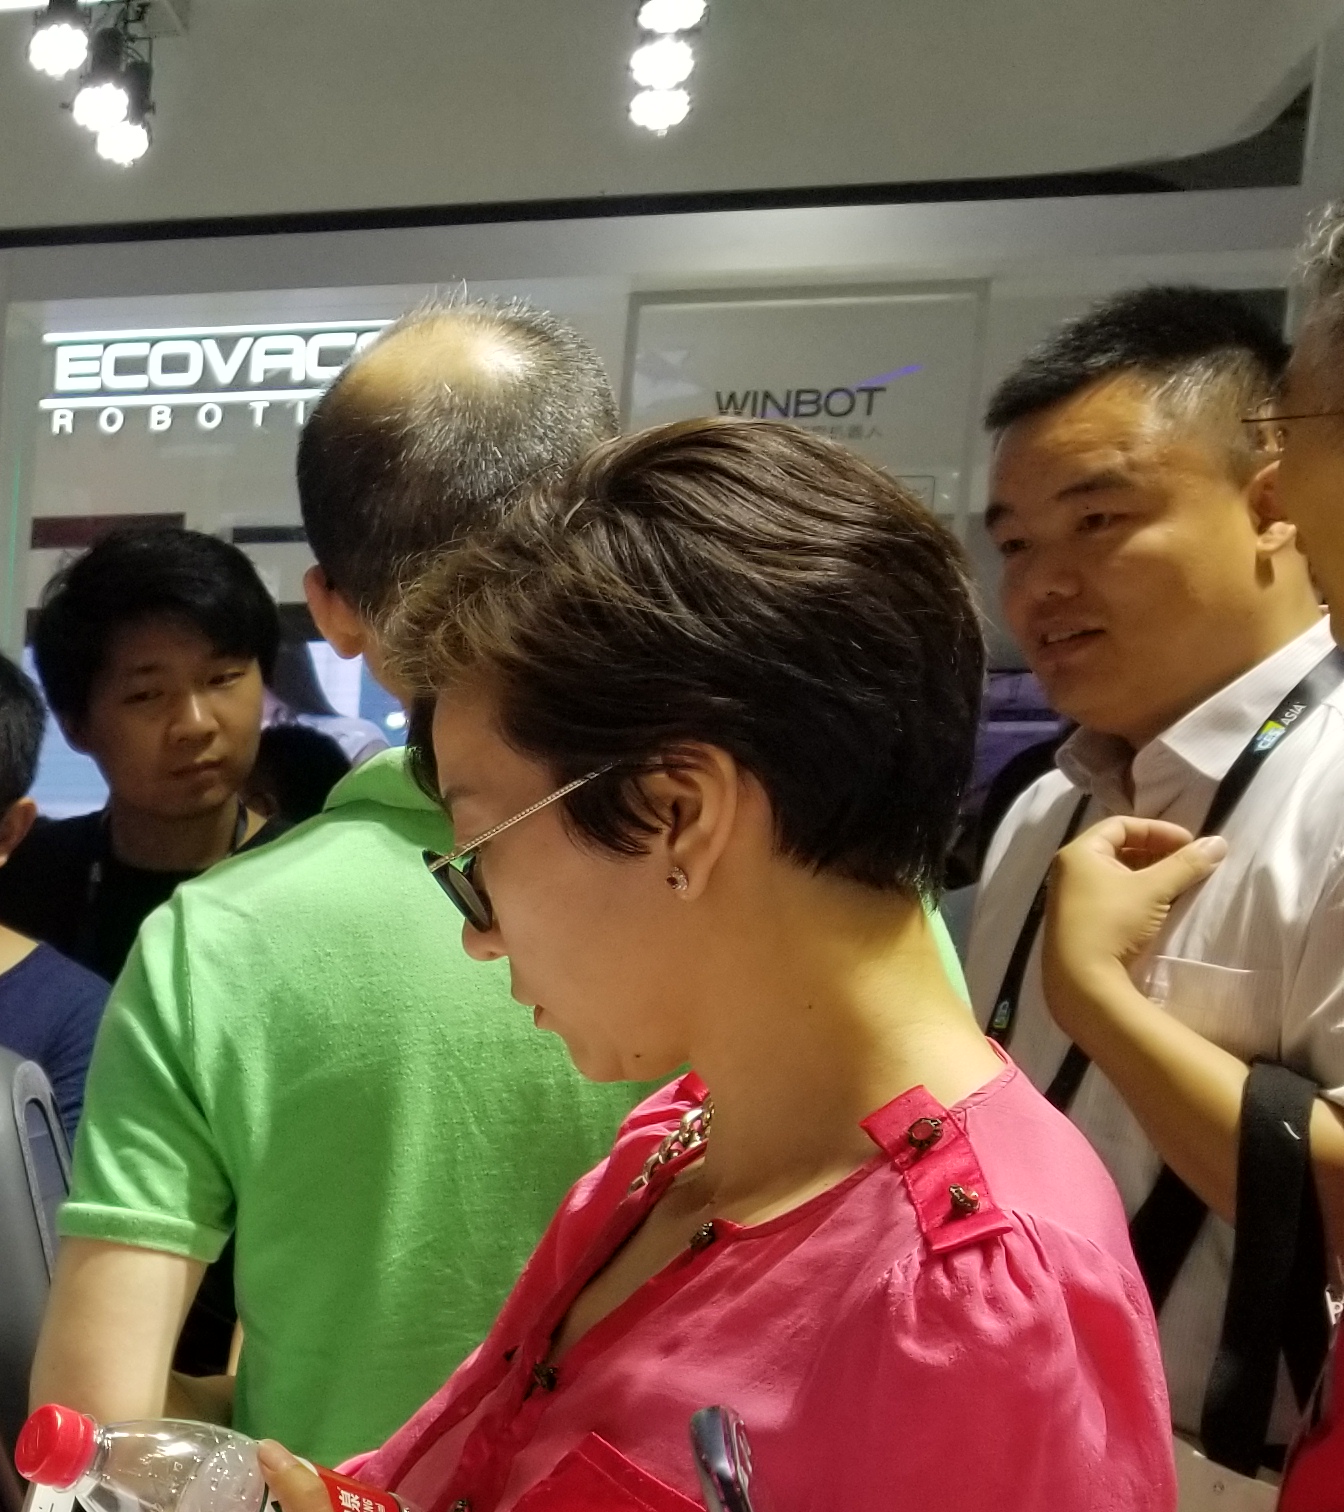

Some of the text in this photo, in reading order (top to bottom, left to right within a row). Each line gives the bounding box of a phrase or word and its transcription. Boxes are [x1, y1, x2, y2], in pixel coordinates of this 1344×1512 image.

[54, 333, 382, 392] ECOVAC
[52, 401, 306, 434] ROBOTI
[716, 387, 886, 418] WINBOT
[1280, 704, 1307, 726] ASIA
